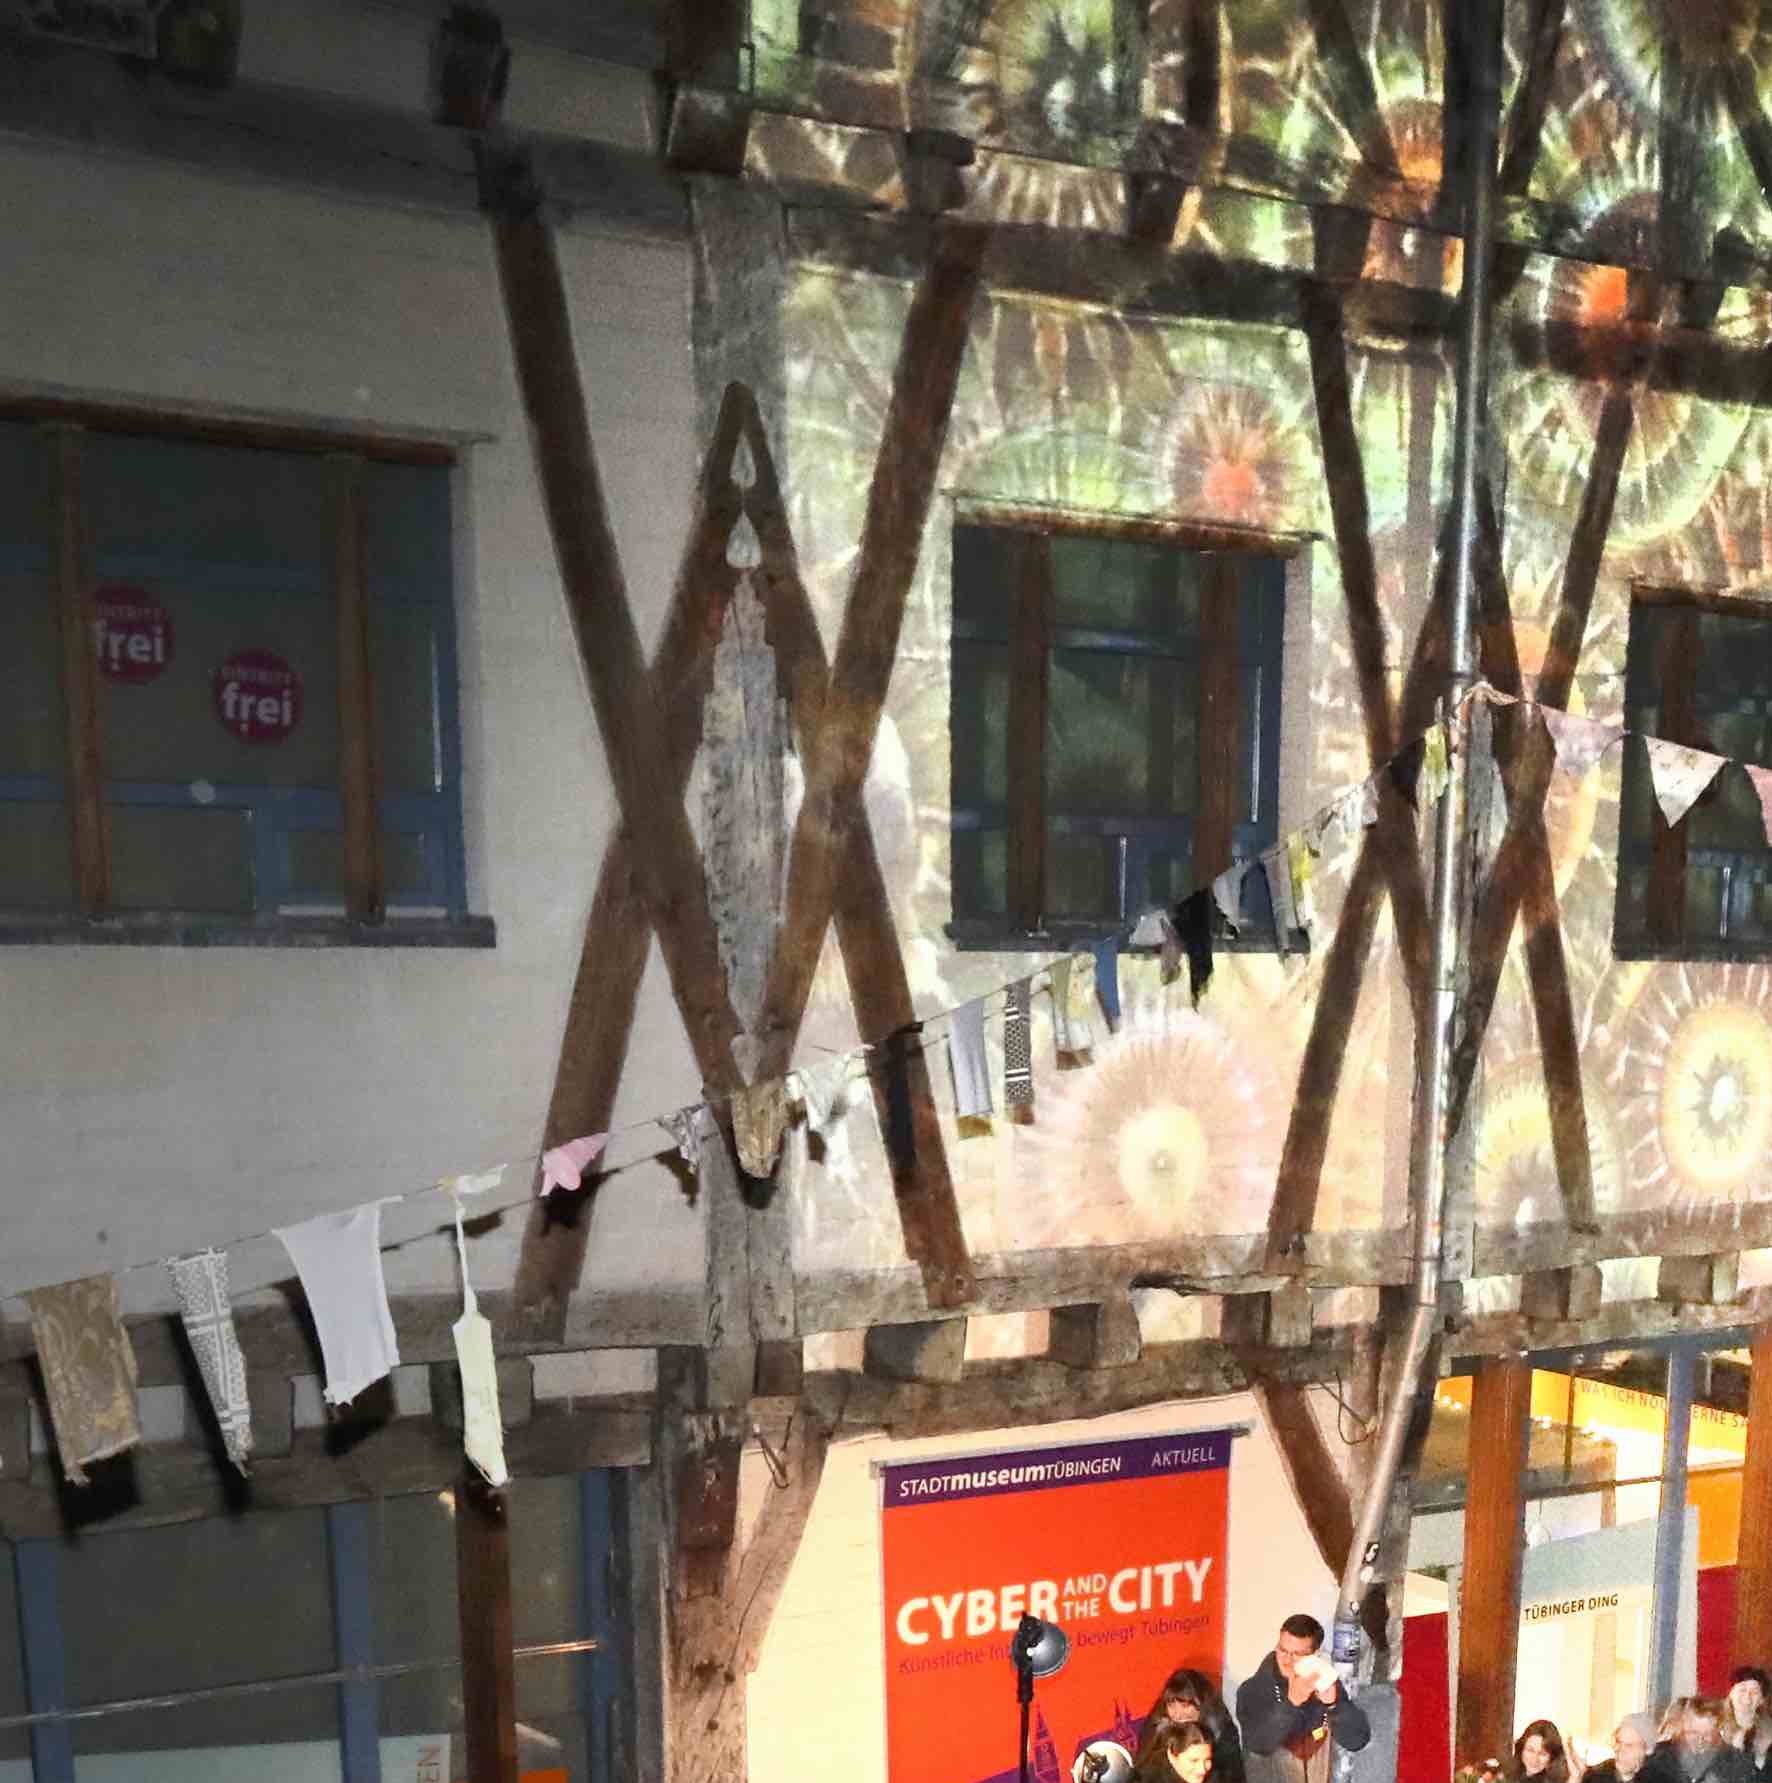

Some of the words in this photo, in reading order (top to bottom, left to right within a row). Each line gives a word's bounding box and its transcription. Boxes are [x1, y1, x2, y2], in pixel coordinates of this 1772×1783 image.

[222, 681, 293, 726] frei
[1151, 1447, 1216, 1468] AKTUELL
[1063, 1573, 1107, 1597] AND
[1109, 1557, 1213, 1614] CITY
[896, 1580, 1060, 1646] CYBER
[1062, 1598, 1100, 1621] THE
[1524, 1599, 1585, 1620] TÜBINGER
[1588, 1593, 1619, 1610] DING
[1076, 1626, 1135, 1648] bewegt
